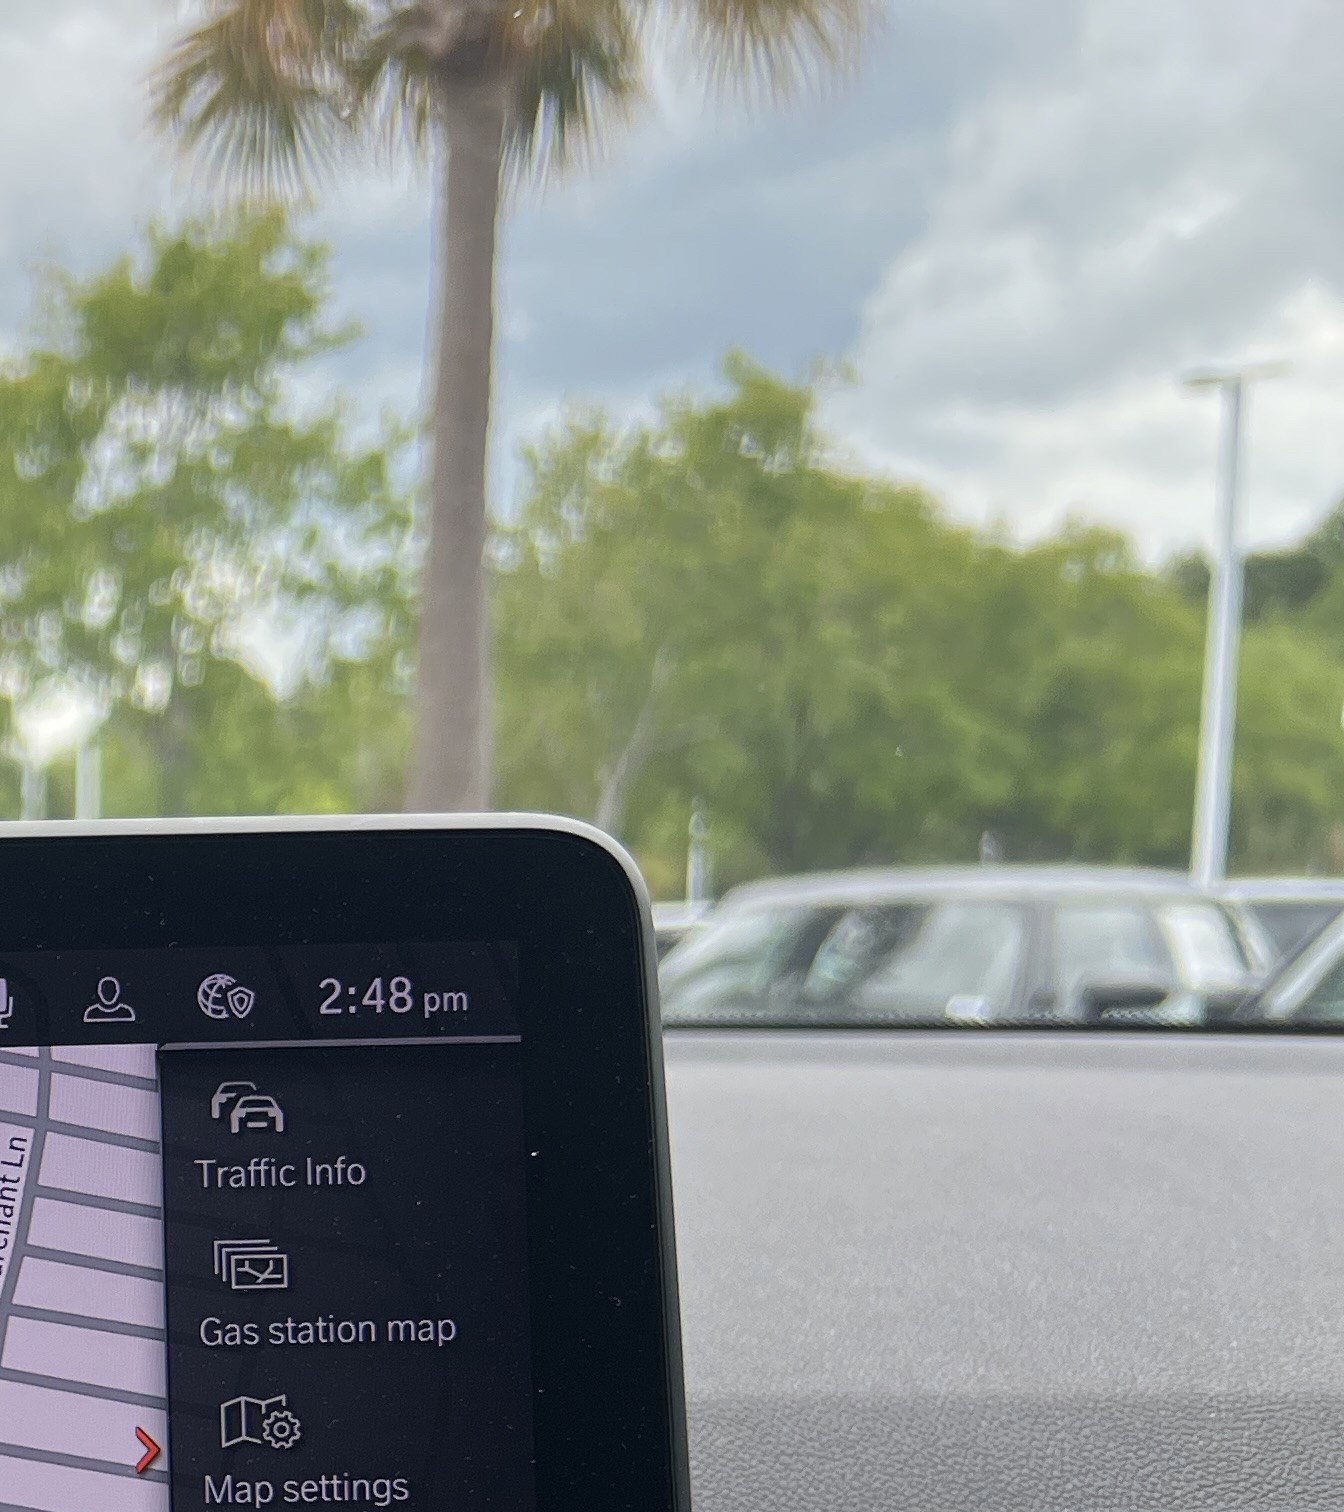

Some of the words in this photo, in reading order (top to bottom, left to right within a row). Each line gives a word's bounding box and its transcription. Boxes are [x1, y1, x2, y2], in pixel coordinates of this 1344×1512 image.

[318, 976, 413, 1015] 2:48
[423, 989, 468, 1019] pm
[0, 1136, 28, 1168] Ln
[193, 1157, 296, 1188] Traffic
[306, 1155, 366, 1186] Info
[200, 1317, 260, 1346] Gas
[268, 1316, 376, 1345] station
[387, 1319, 456, 1347] map
[204, 1474, 274, 1509] Map
[283, 1474, 409, 1507] settings
